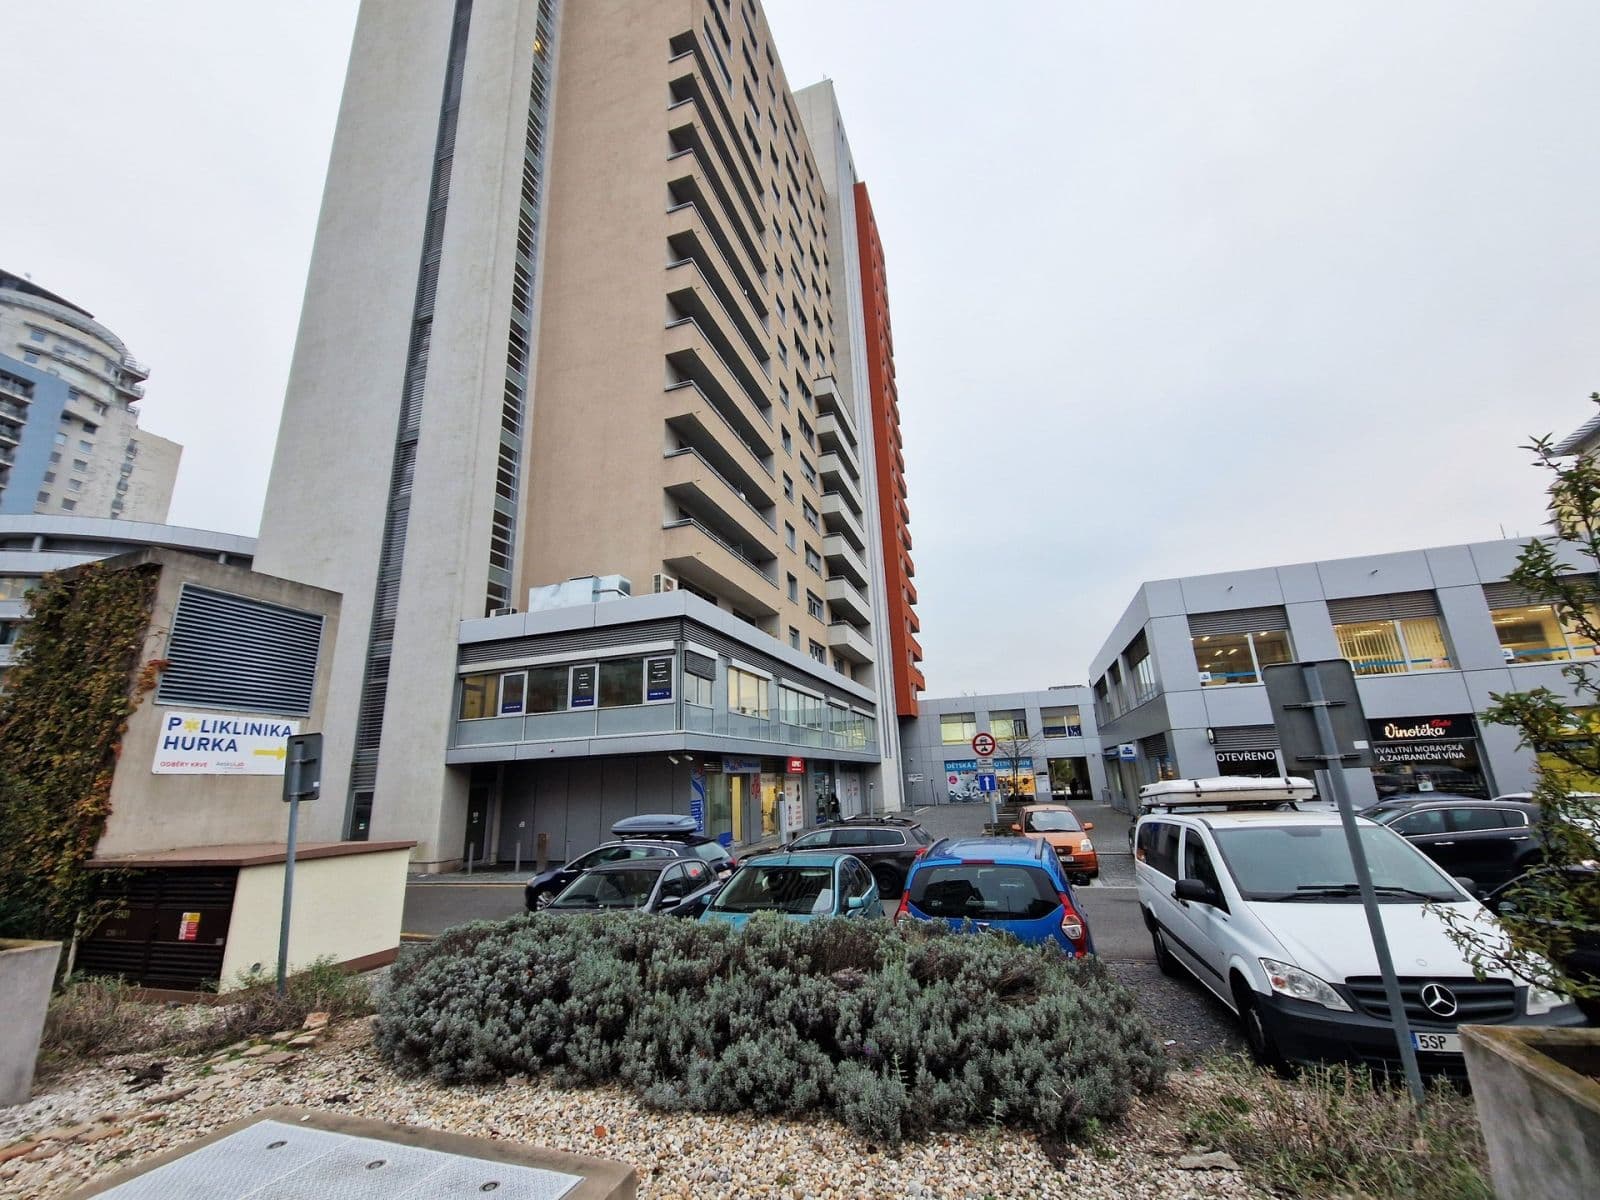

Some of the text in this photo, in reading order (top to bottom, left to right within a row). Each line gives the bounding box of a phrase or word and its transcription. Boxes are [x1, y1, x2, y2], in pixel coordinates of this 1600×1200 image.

[1384, 723, 1446, 738] Vinotéka
[163, 735, 238, 752] HURKA
[1374, 743, 1464, 754] KVALITNÍ MORAVSKÁ
[1216, 751, 1275, 762] OTEVŘENO
[1387, 751, 1441, 761] ZAHRANIČNÍ
[1442, 750, 1466, 759] VÍNA
[1418, 1035, 1446, 1049] 5SP
